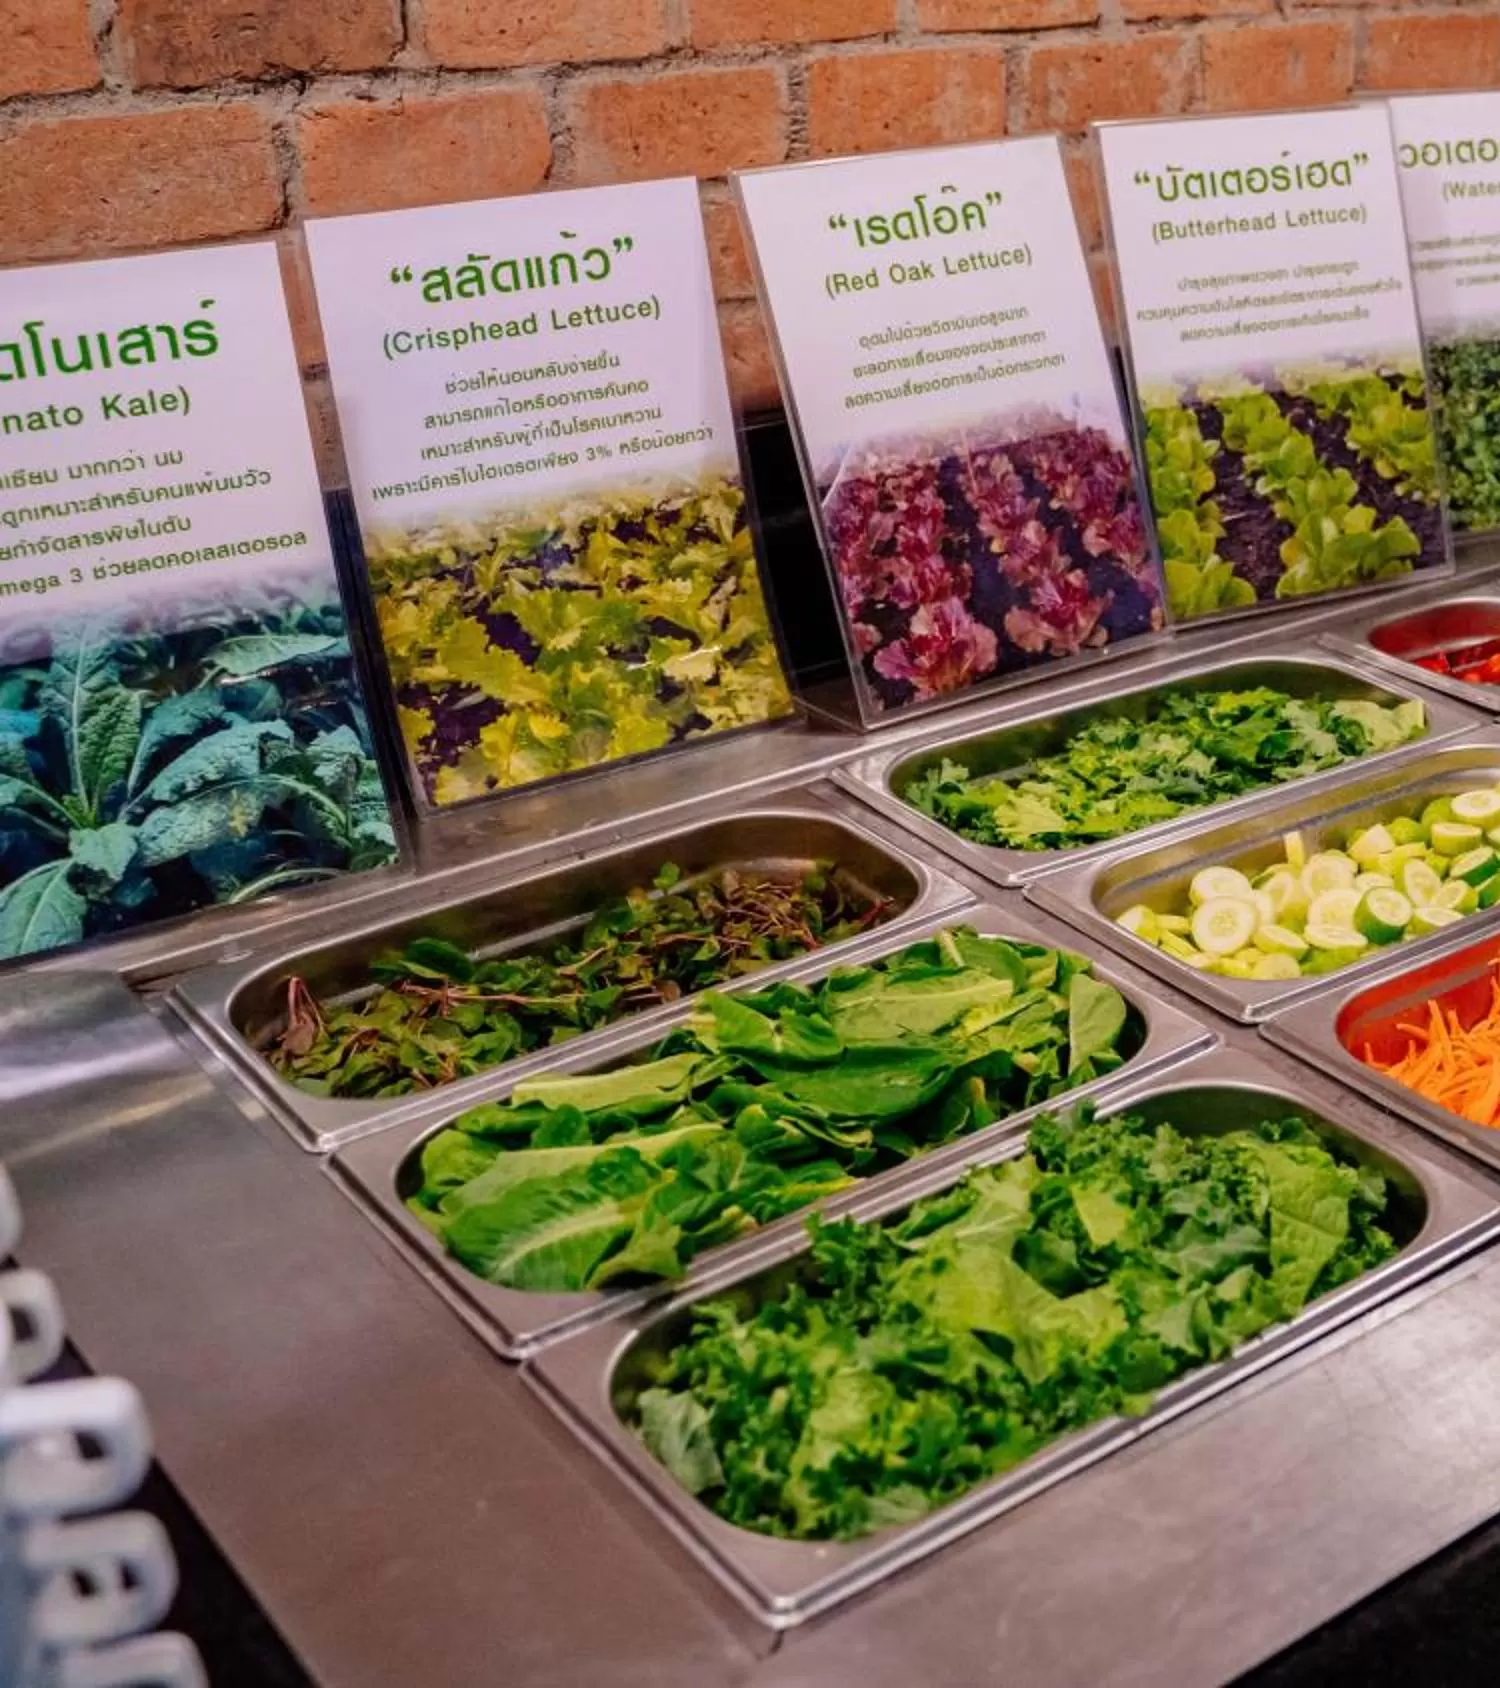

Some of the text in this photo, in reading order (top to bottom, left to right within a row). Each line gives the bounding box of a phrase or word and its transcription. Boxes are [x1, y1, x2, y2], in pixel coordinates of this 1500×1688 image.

[1152, 204, 1368, 245] (Butterhead Lettuce)
[390, 231, 633, 303] “สลัดแก้ว”
[825, 243, 1033, 300] (Red Oak Lettuce)
[383, 295, 661, 360] (Crisphead Lettuce)
[2, 385, 191, 435] nato Kale)
[68, 449, 144, 479] มากกว่า
[155, 449, 183, 468] นม
[585, 445, 613, 462] 3%
[0, 469, 272, 529] ดูกเหมาะสำหรับคนแพ้นมวัว
[0, 575, 61, 597] mega
[70, 567, 83, 583] 3
